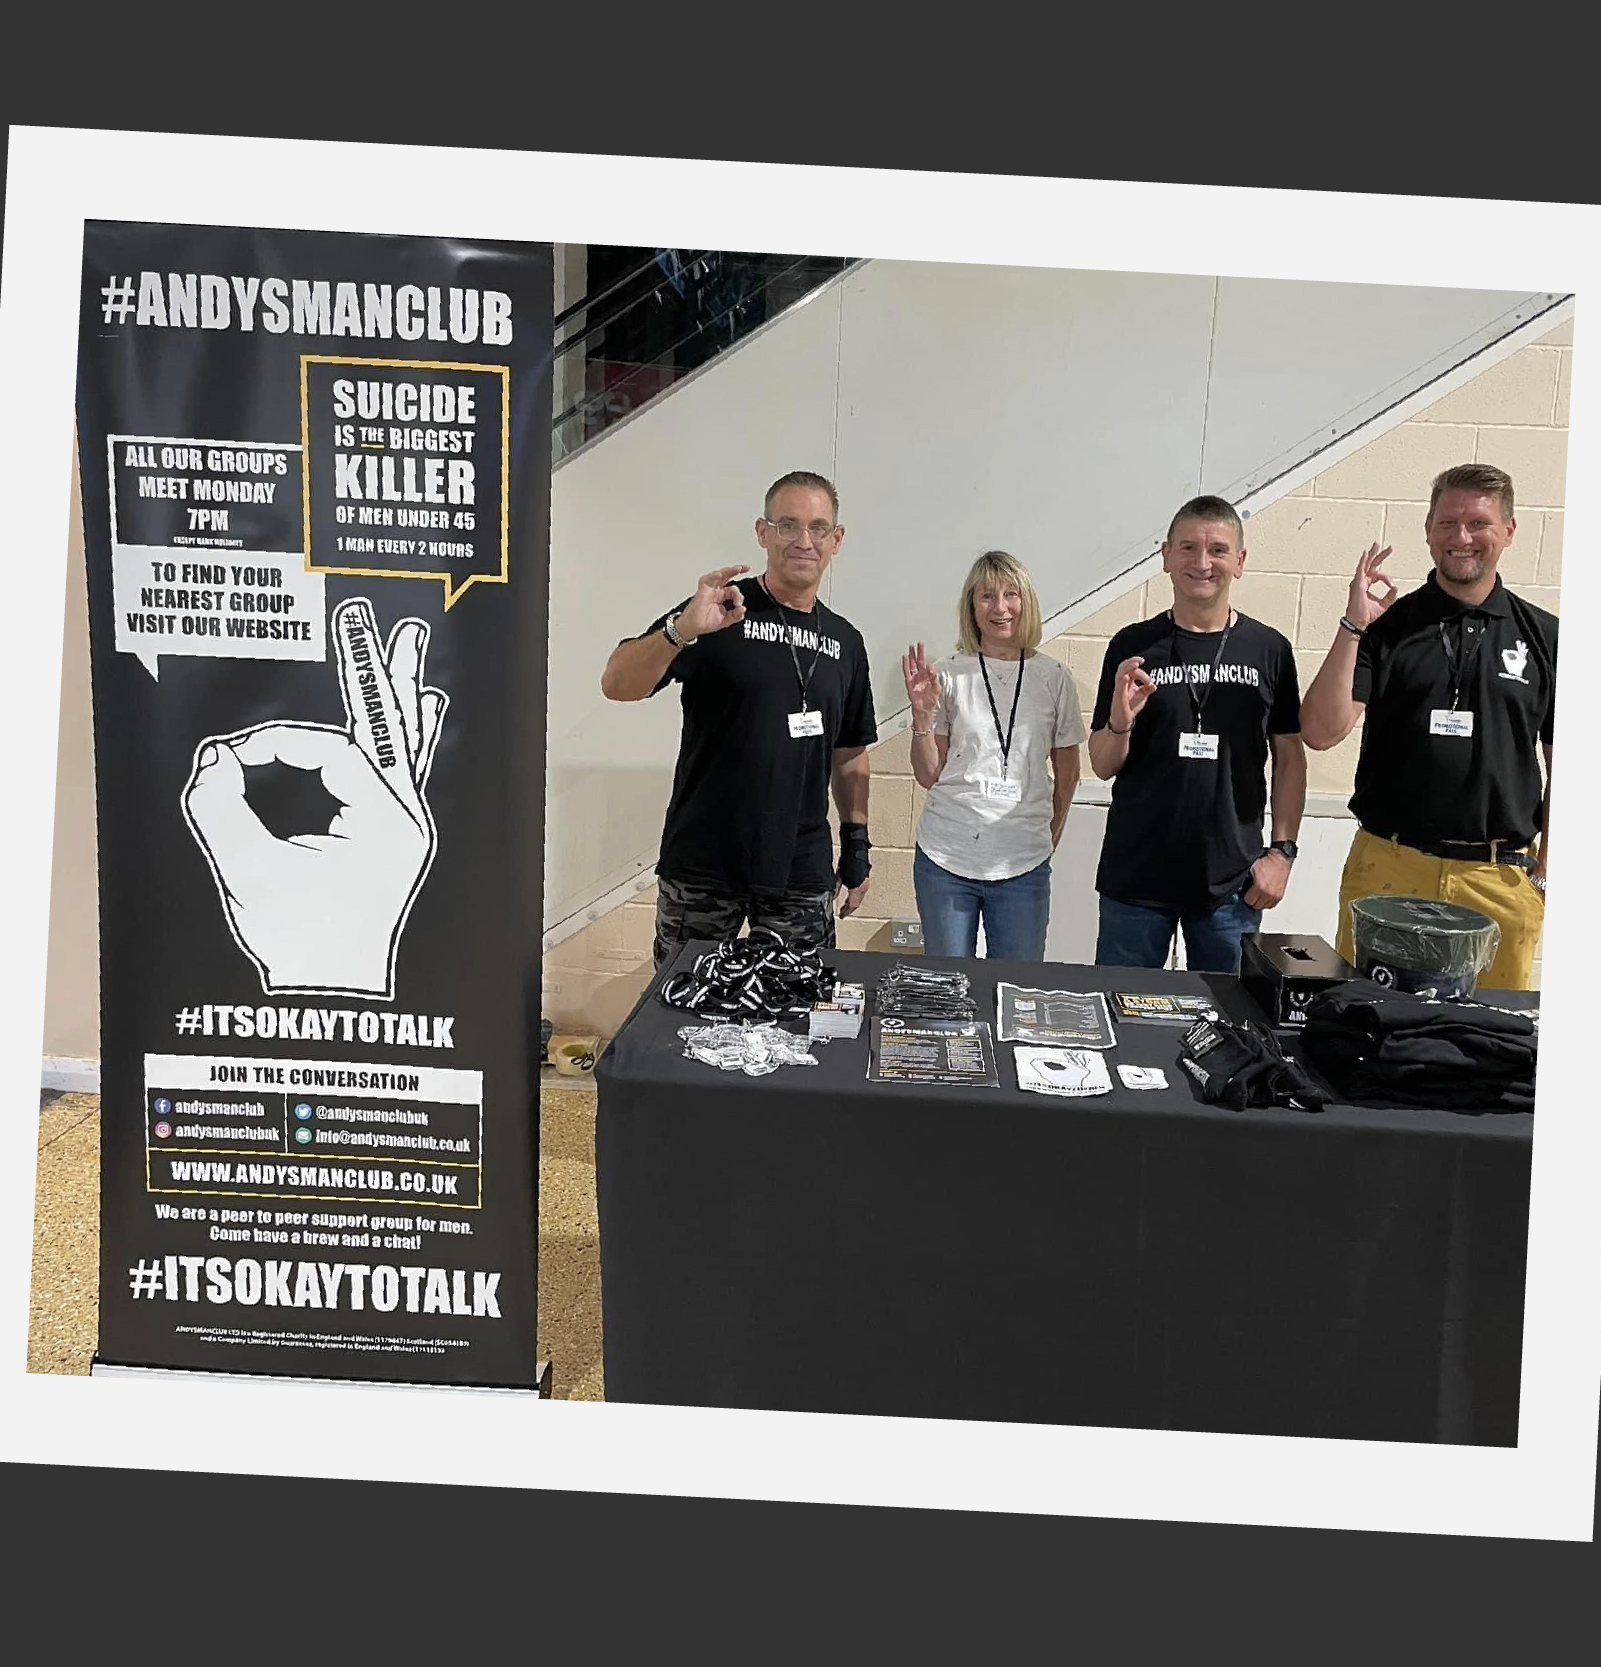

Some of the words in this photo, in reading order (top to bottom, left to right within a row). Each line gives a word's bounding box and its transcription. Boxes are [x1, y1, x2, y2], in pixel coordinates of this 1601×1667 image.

[101, 271, 513, 346] #ANDYSMANCLUB
[333, 379, 476, 424] SUICIDE
[335, 425, 355, 447] IS
[359, 426, 384, 442] THE
[389, 427, 475, 453] BIGGEST
[125, 445, 157, 468] ALL
[161, 447, 203, 471] OUR
[207, 450, 287, 475] GROUPS
[139, 476, 188, 499] MEET
[193, 479, 276, 504] MONDAY
[335, 453, 475, 505] KILLER
[187, 508, 228, 531] 7PM
[335, 505, 355, 524] OF
[358, 507, 393, 526] MEN
[397, 509, 450, 529] UNDER
[453, 511, 475, 531] 45
[336, 537, 343, 551] 1
[345, 537, 374, 553] MAN
[377, 539, 415, 555] EVERY
[418, 540, 426, 555] 2
[429, 541, 474, 558] HOURS
[152, 562, 176, 582] TO
[182, 564, 225, 585] FIND
[231, 566, 282, 588] YOUR
[141, 587, 225, 610] NEAREST
[230, 592, 294, 614] GROUP
[127, 613, 176, 634] VISIT
[182, 615, 221, 637] OUR
[226, 618, 311, 641] WEBSITE
[343, 611, 397, 770] #ANDYSMANCLUB
[175, 1004, 455, 1049] #ITSOKAYTOTALK
[210, 1065, 248, 1083] JOIN
[253, 1067, 284, 1085] THE
[290, 1068, 419, 1091] CONVERSATION
[175, 1100, 265, 1118] andysmanclub
[316, 1106, 429, 1126] @andysmanclubuk
[175, 1122, 280, 1142] andysmanclubuk
[171, 1160, 458, 1195] WWW.ANDYSMANCLUB.CO.UK
[155, 1203, 179, 1220] We
[181, 1208, 207, 1221] are
[209, 1209, 219, 1222] a
[221, 1209, 254, 1224] peer
[257, 1210, 272, 1224] to
[275, 1211, 309, 1227] peer
[311, 1213, 369, 1230] support
[371, 1217, 413, 1232] group
[416, 1217, 437, 1232] for
[439, 1220, 474, 1235] men.
[210, 1225, 251, 1243] Come
[253, 1226, 288, 1244] have
[291, 1232, 301, 1245] a
[303, 1230, 339, 1246] brew
[342, 1232, 370, 1248] and
[372, 1236, 382, 1248] a
[384, 1233, 422, 1250] chat!
[129, 1255, 502, 1318] #ITSOKAYTOTALK
